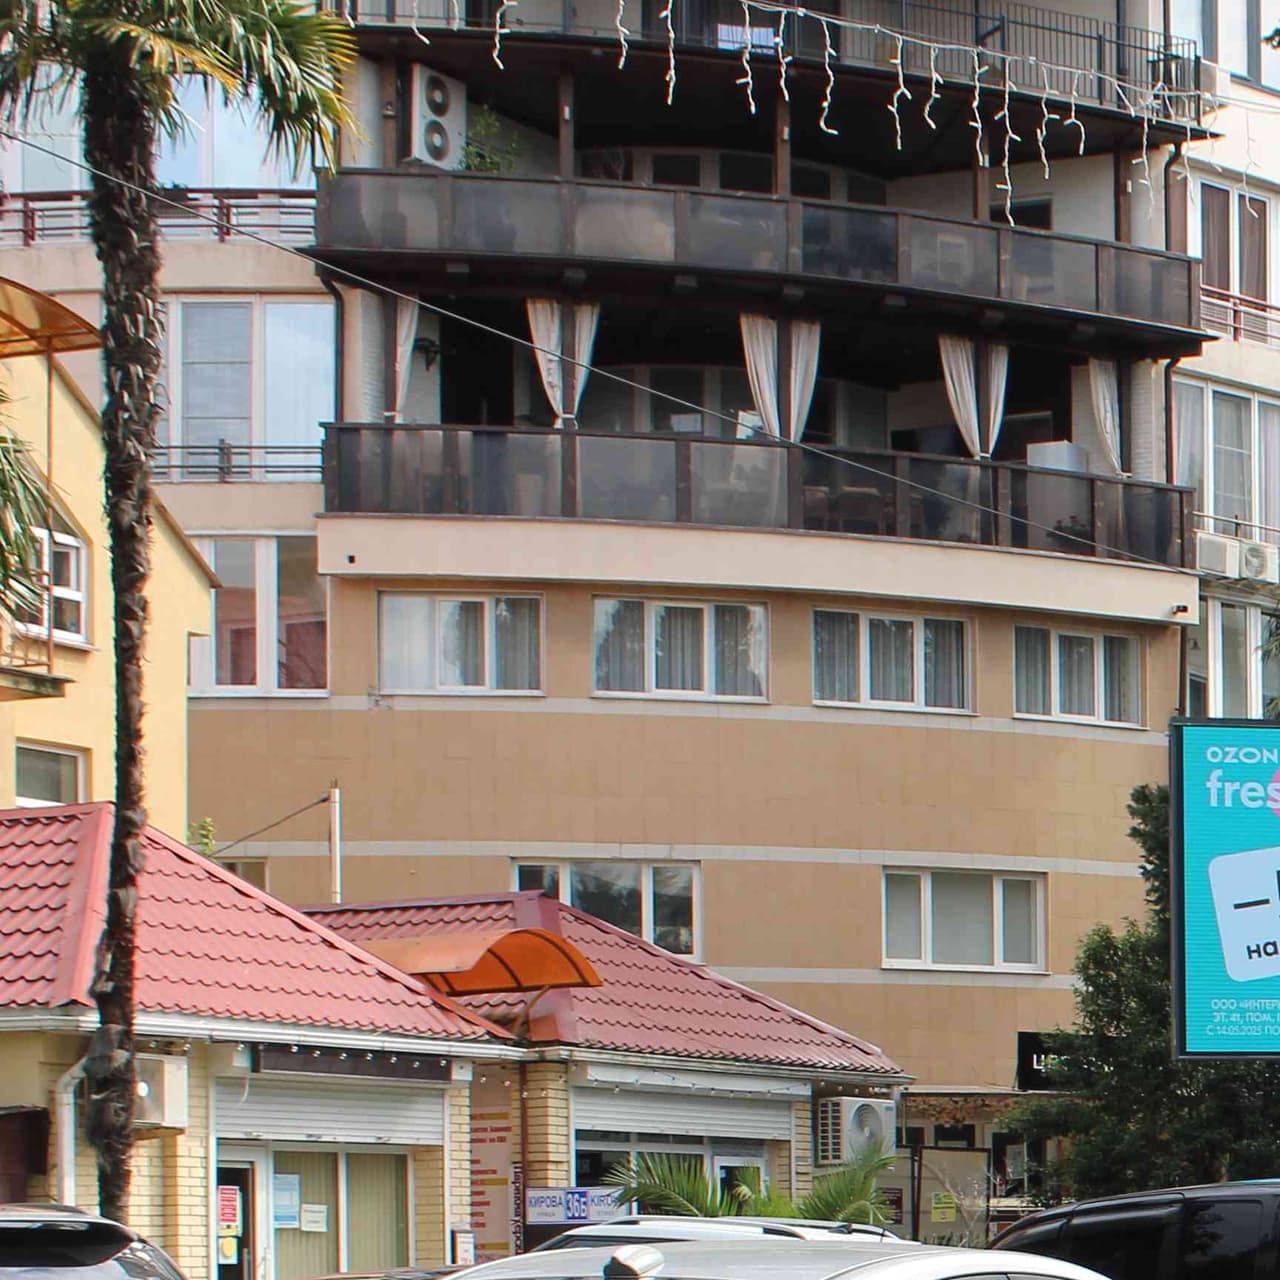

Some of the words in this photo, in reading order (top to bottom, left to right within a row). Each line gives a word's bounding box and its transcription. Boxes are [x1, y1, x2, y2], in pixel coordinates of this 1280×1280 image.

[1206, 746, 1278, 764] OZON
[1246, 940, 1279, 960] на
[1211, 999, 1237, 1010] ООО
[1245, 1013, 1275, 1023] ПОМ.
[1264, 1025, 1280, 1036] ПО
[528, 1196, 563, 1208] КИРОВА
[566, 1193, 587, 1217] 36Б
